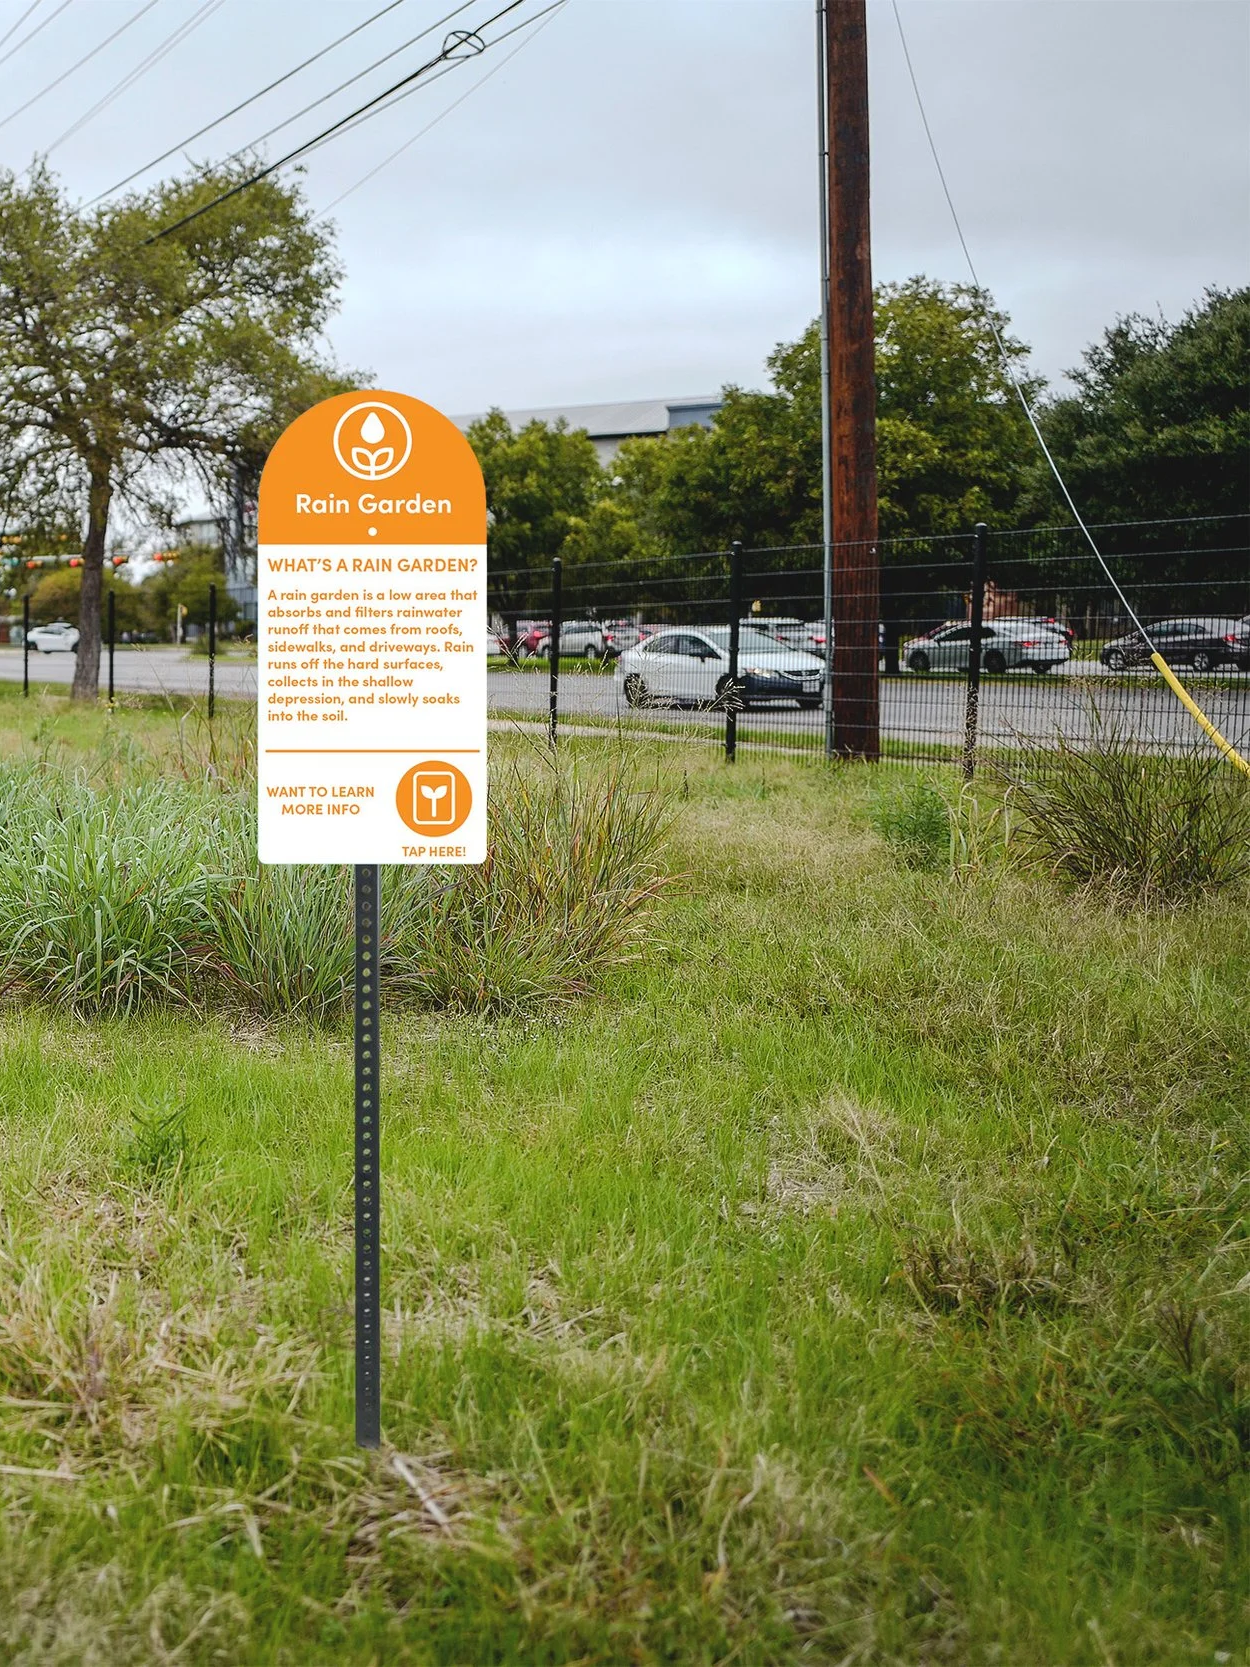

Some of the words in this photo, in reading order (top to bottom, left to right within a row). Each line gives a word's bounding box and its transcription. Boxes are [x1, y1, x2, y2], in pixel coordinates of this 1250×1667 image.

[297, 494, 349, 513] Rain
[358, 494, 451, 513] Garden
[267, 558, 332, 572] WHAT’S
[336, 558, 348, 572] A
[352, 558, 392, 572] RAIN
[397, 558, 478, 572] GARDEN?
[268, 589, 277, 600] A
[280, 589, 307, 600] rain
[311, 589, 359, 604] garden
[363, 589, 373, 600] is
[376, 592, 385, 600] a
[389, 589, 412, 600] low
[415, 592, 446, 600] area
[450, 589, 478, 600] that
[267, 606, 322, 618] absorbs
[325, 606, 351, 618] and
[355, 606, 393, 618] filters
[397, 606, 462, 618] rainwater
[268, 623, 309, 635] runoff
[312, 624, 340, 635] that
[344, 627, 387, 635] comes
[390, 623, 422, 635] from
[426, 623, 462, 636] roofs,
[268, 641, 336, 654] sidewalks,
[340, 641, 365, 652] and
[369, 641, 440, 655] driveways.
[444, 641, 474, 652] Rain
[268, 661, 297, 669] runs
[300, 658, 320, 670] off
[323, 658, 345, 669] the
[348, 658, 379, 669] hard
[383, 658, 443, 671] surfaces,
[268, 675, 318, 687] collects
[322, 676, 334, 687] in
[338, 676, 359, 687] the
[362, 675, 413, 687] shallow
[268, 693, 344, 707] depression,
[348, 692, 374, 704] and
[378, 692, 419, 707] slowly
[423, 693, 460, 704] soaks
[268, 710, 293, 721] into
[296, 710, 318, 721] the
[322, 710, 348, 721] soil.
[266, 786, 306, 797] WANT
[309, 786, 328, 798] TO
[332, 786, 374, 798] LEARN
[282, 804, 323, 815] MORE
[327, 804, 360, 815] INFO
[402, 846, 426, 857] TAP
[429, 846, 466, 857] HERE!
